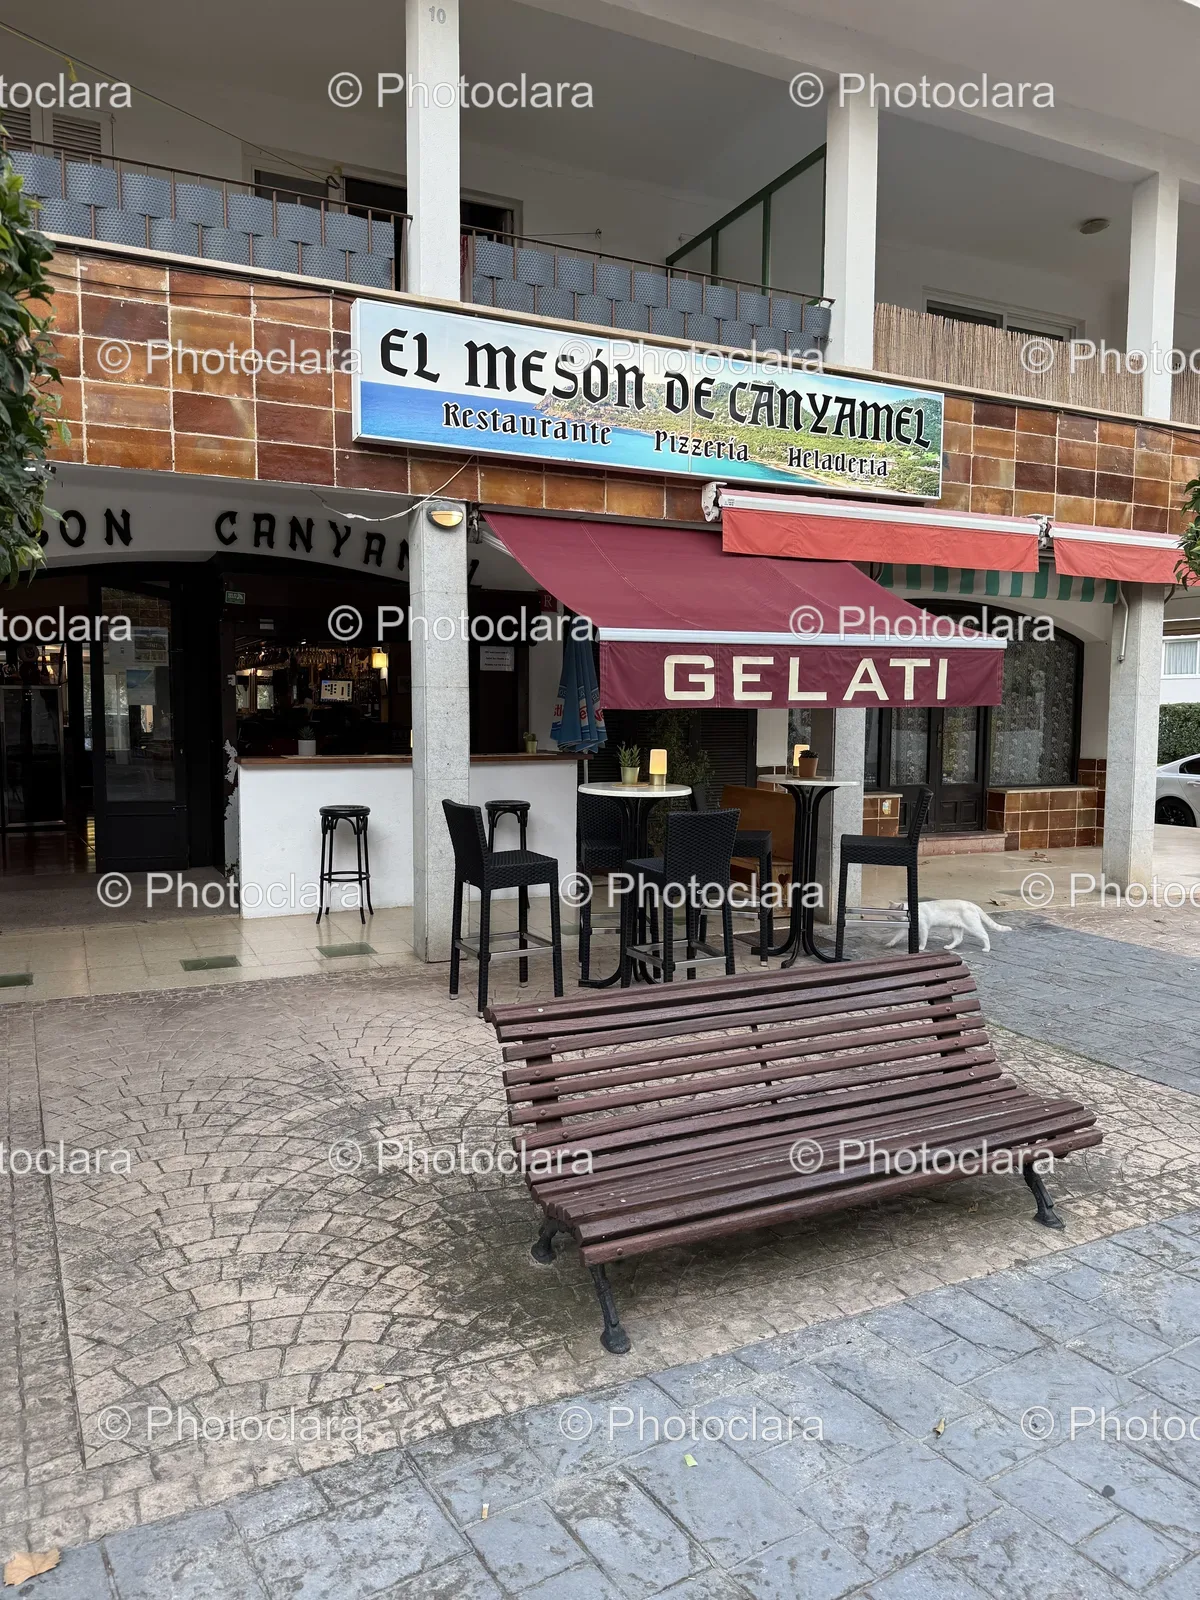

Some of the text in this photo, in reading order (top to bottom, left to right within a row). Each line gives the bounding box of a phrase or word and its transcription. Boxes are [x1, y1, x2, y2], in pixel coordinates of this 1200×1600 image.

[429, 6, 446, 24] 10
[381, 328, 440, 383] EL
[665, 370, 715, 420] DE
[730, 381, 931, 449] CANYAMEL
[443, 402, 888, 477] Restaurante Pizzería Heladería
[664, 654, 949, 701] GELATI
